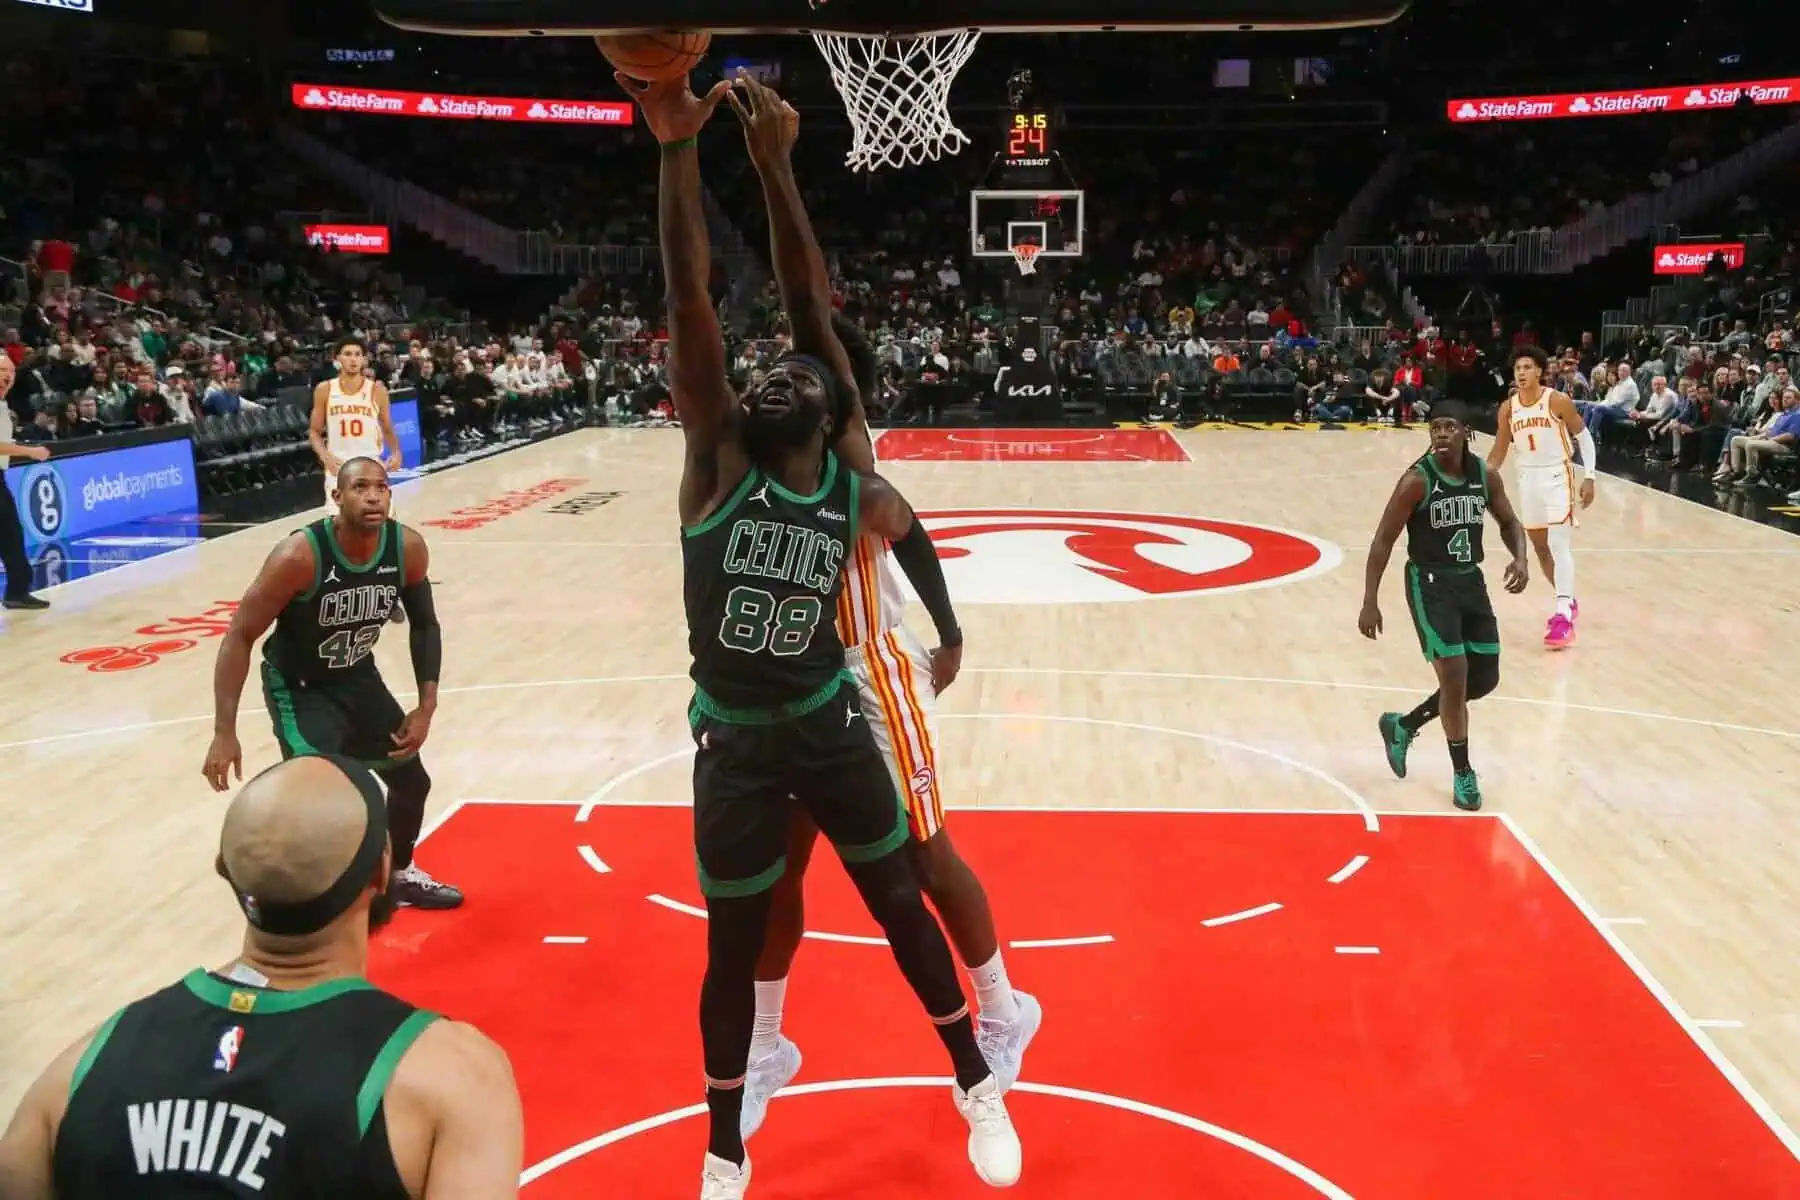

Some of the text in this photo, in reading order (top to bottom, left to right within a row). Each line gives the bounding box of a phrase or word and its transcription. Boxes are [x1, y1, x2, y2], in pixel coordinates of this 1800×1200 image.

[1015, 114, 1047, 129] 9:15
[1010, 128, 1043, 154] 24
[329, 404, 372, 417] ATLANTA
[339, 419, 363, 437] 10
[1527, 433, 1536, 451] 1
[1430, 496, 1485, 529] CELTICS
[723, 519, 844, 595] CELTICS
[1447, 528, 1471, 562] 4
[319, 584, 397, 627] CELTICS
[718, 585, 822, 656] 88
[318, 624, 381, 669] 42
[127, 1098, 287, 1191] WHITE
